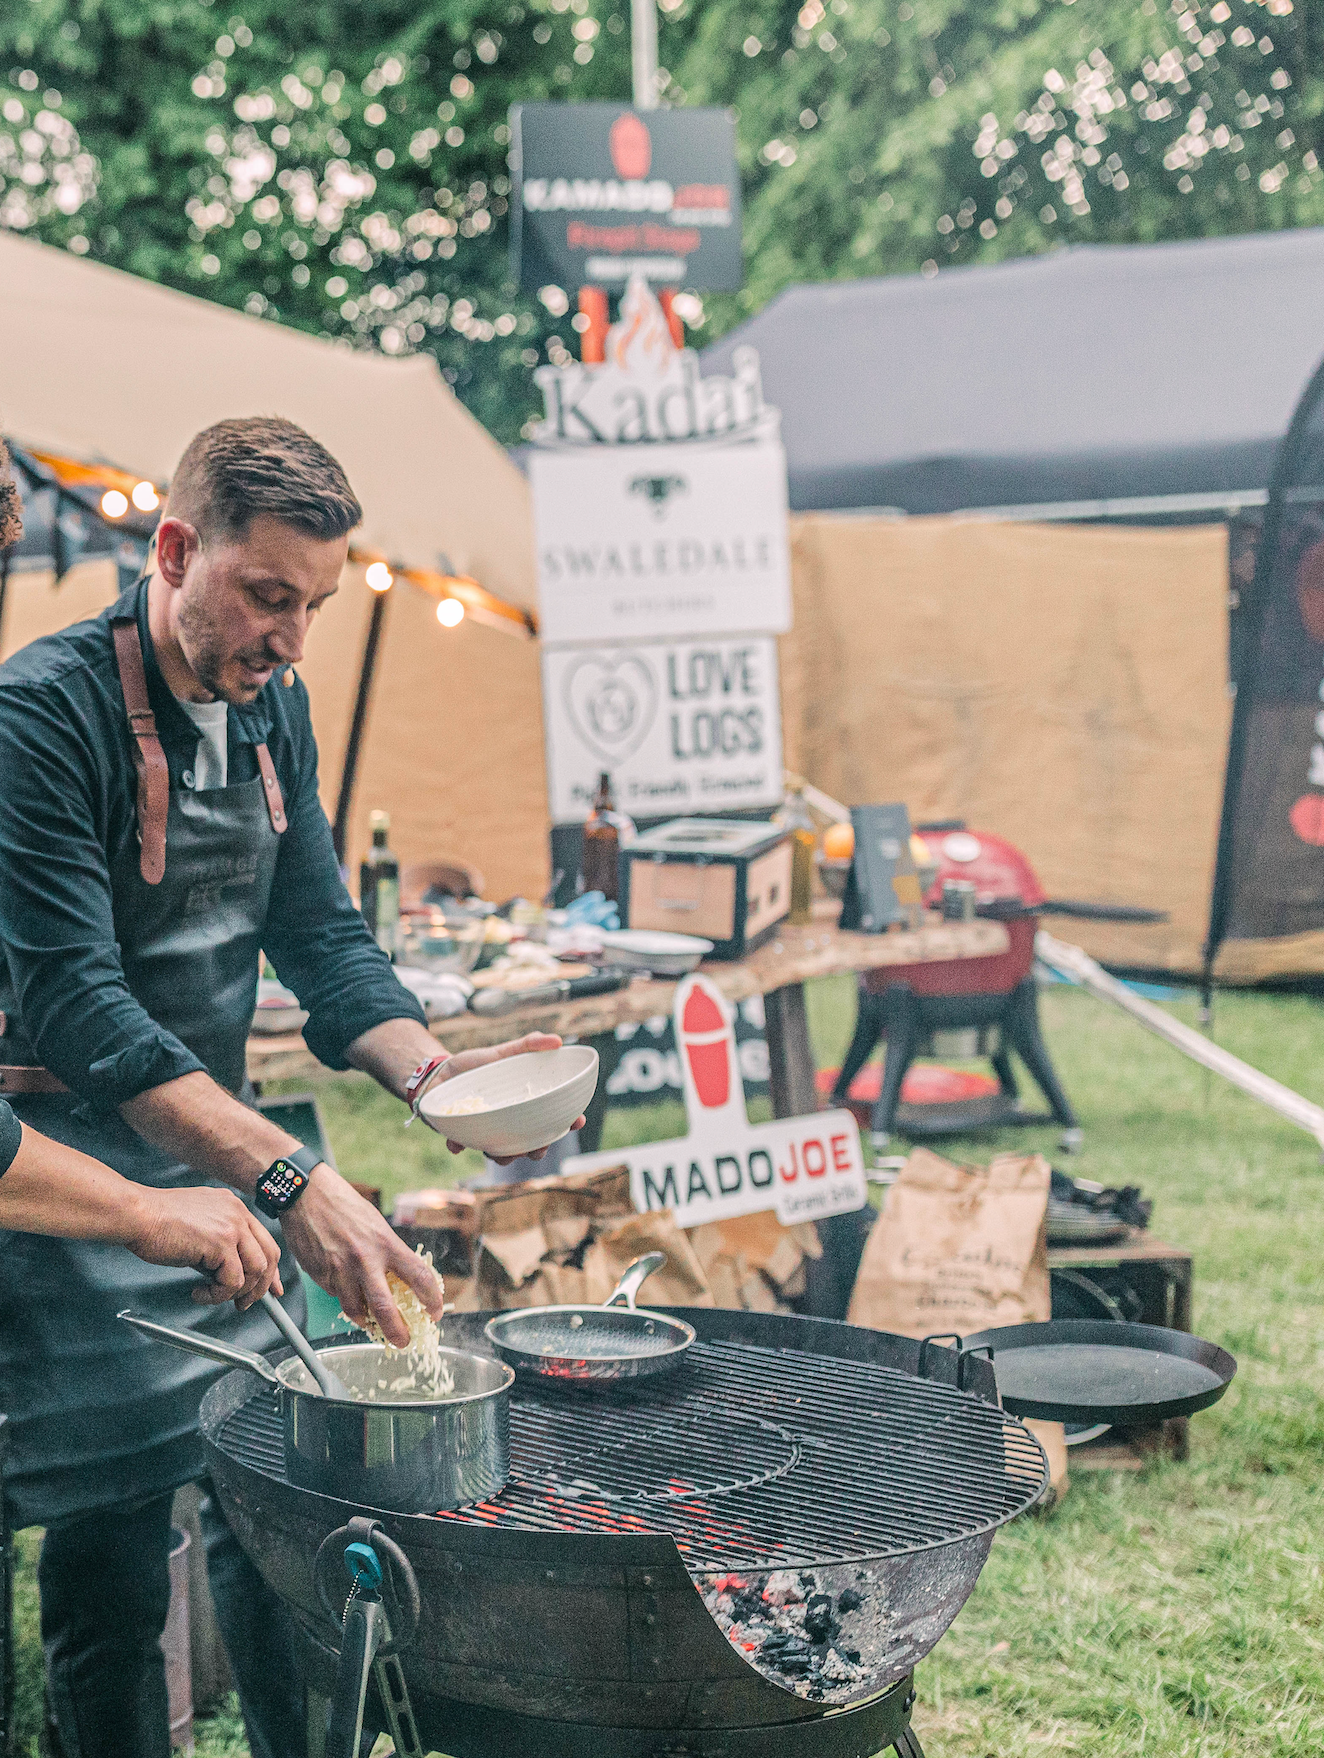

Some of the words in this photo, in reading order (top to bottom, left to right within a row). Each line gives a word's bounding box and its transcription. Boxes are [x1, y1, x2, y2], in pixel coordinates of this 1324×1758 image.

[542, 349, 766, 441] Kadai
[545, 539, 772, 580] SWALEDALE
[667, 648, 760, 699] LOVE
[670, 708, 764, 762] LOGS
[641, 1134, 852, 1214] MADOJOE
